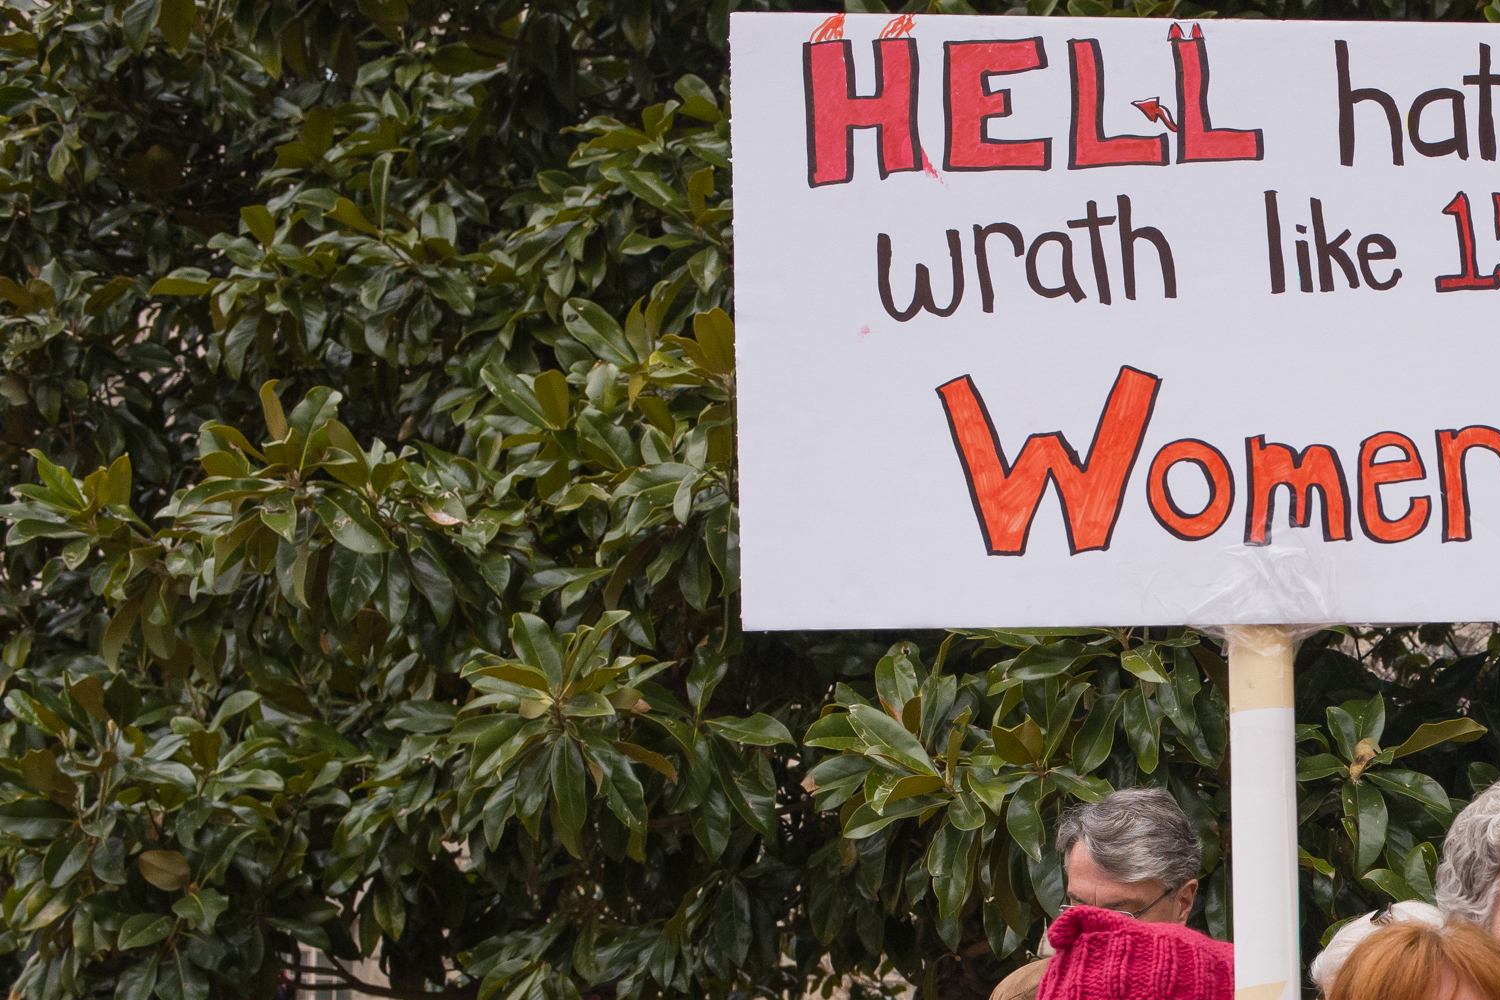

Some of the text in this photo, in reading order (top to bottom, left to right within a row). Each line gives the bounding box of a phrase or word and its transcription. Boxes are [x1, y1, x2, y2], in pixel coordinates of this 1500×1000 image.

[803, 33, 1265, 189] HELL
[877, 194, 1177, 322] wrath
[1264, 189, 1403, 295] like
